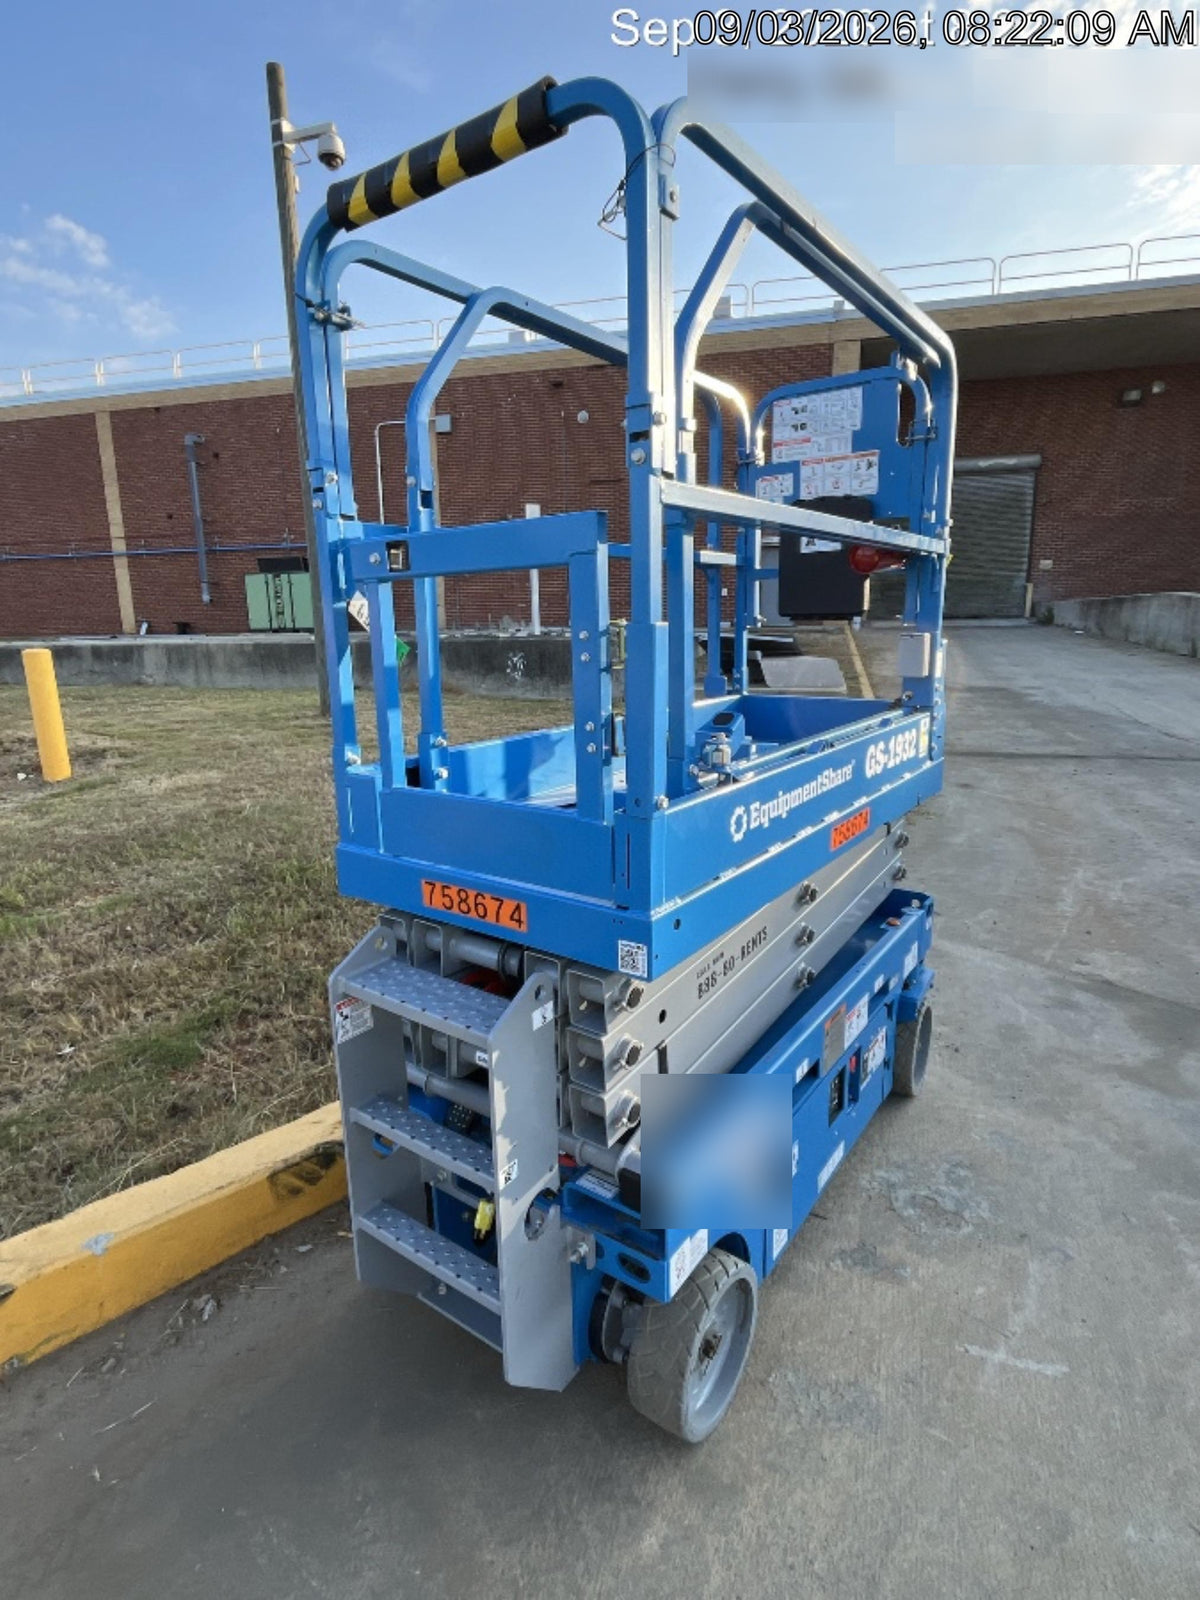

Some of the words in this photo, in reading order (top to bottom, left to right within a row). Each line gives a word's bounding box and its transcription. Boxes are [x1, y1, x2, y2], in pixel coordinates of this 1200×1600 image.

[865, 728, 917, 778] GS-1932
[749, 764, 853, 829] EquipmentShare
[424, 880, 524, 929] 758674
